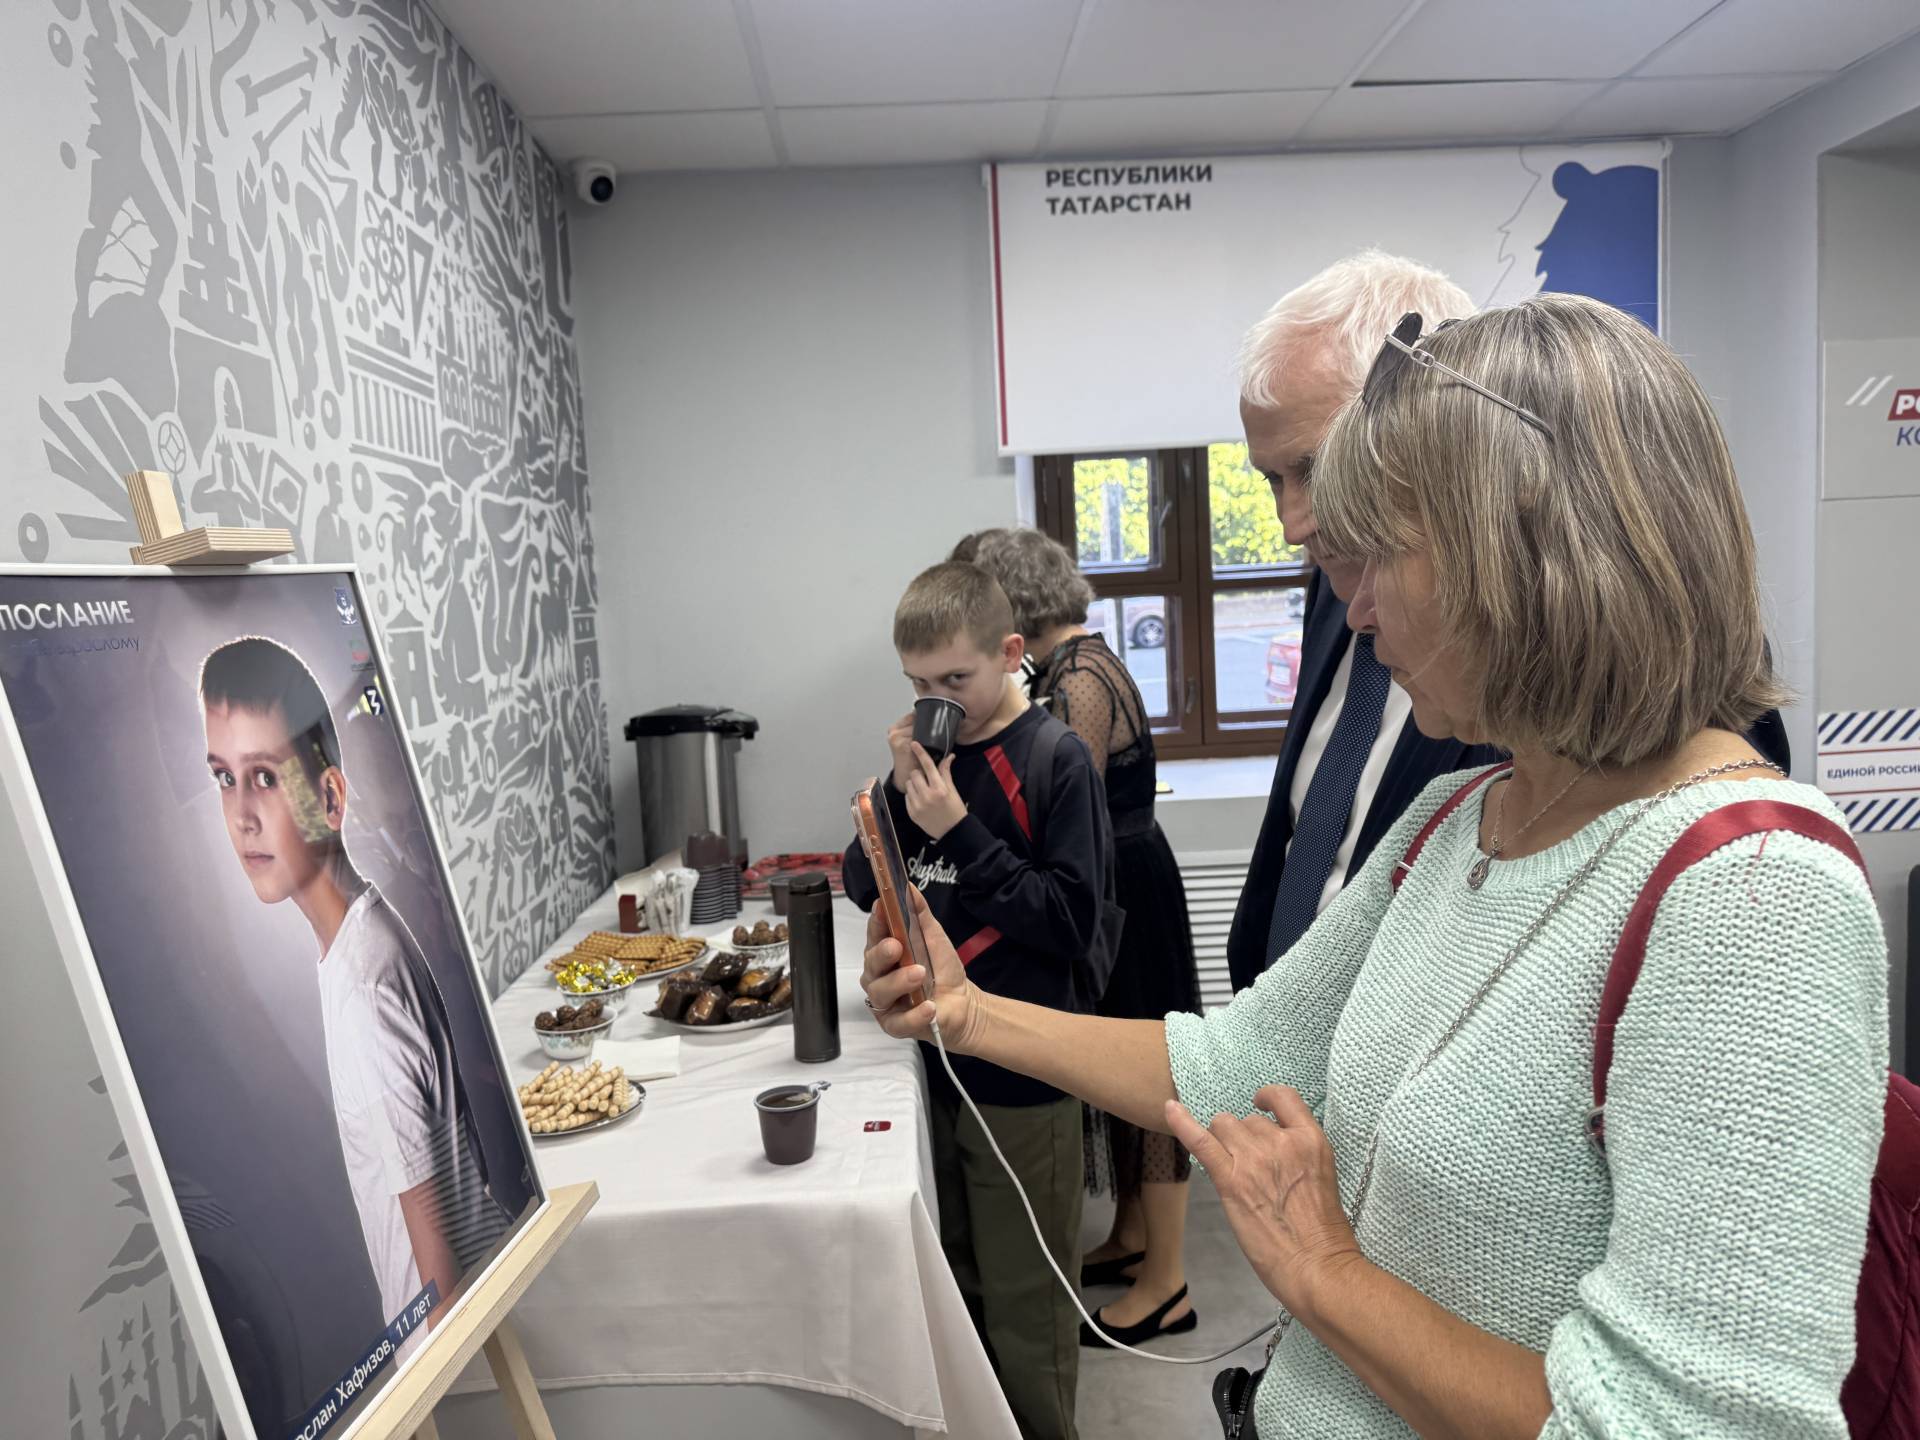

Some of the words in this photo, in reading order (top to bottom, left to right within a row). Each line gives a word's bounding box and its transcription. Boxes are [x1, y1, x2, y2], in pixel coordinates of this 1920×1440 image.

[1046, 164, 1212, 187] РЕСПУБЛИКИ
[1046, 193, 1191, 215] ТАТАРСТАН
[0, 600, 135, 631] ПОСЛАНИЕ
[1827, 765, 1875, 779] ЕДИНОЙ
[336, 1339, 396, 1406] Хафизов,
[396, 1313, 410, 1338] 11
[413, 1293, 431, 1323] лет
